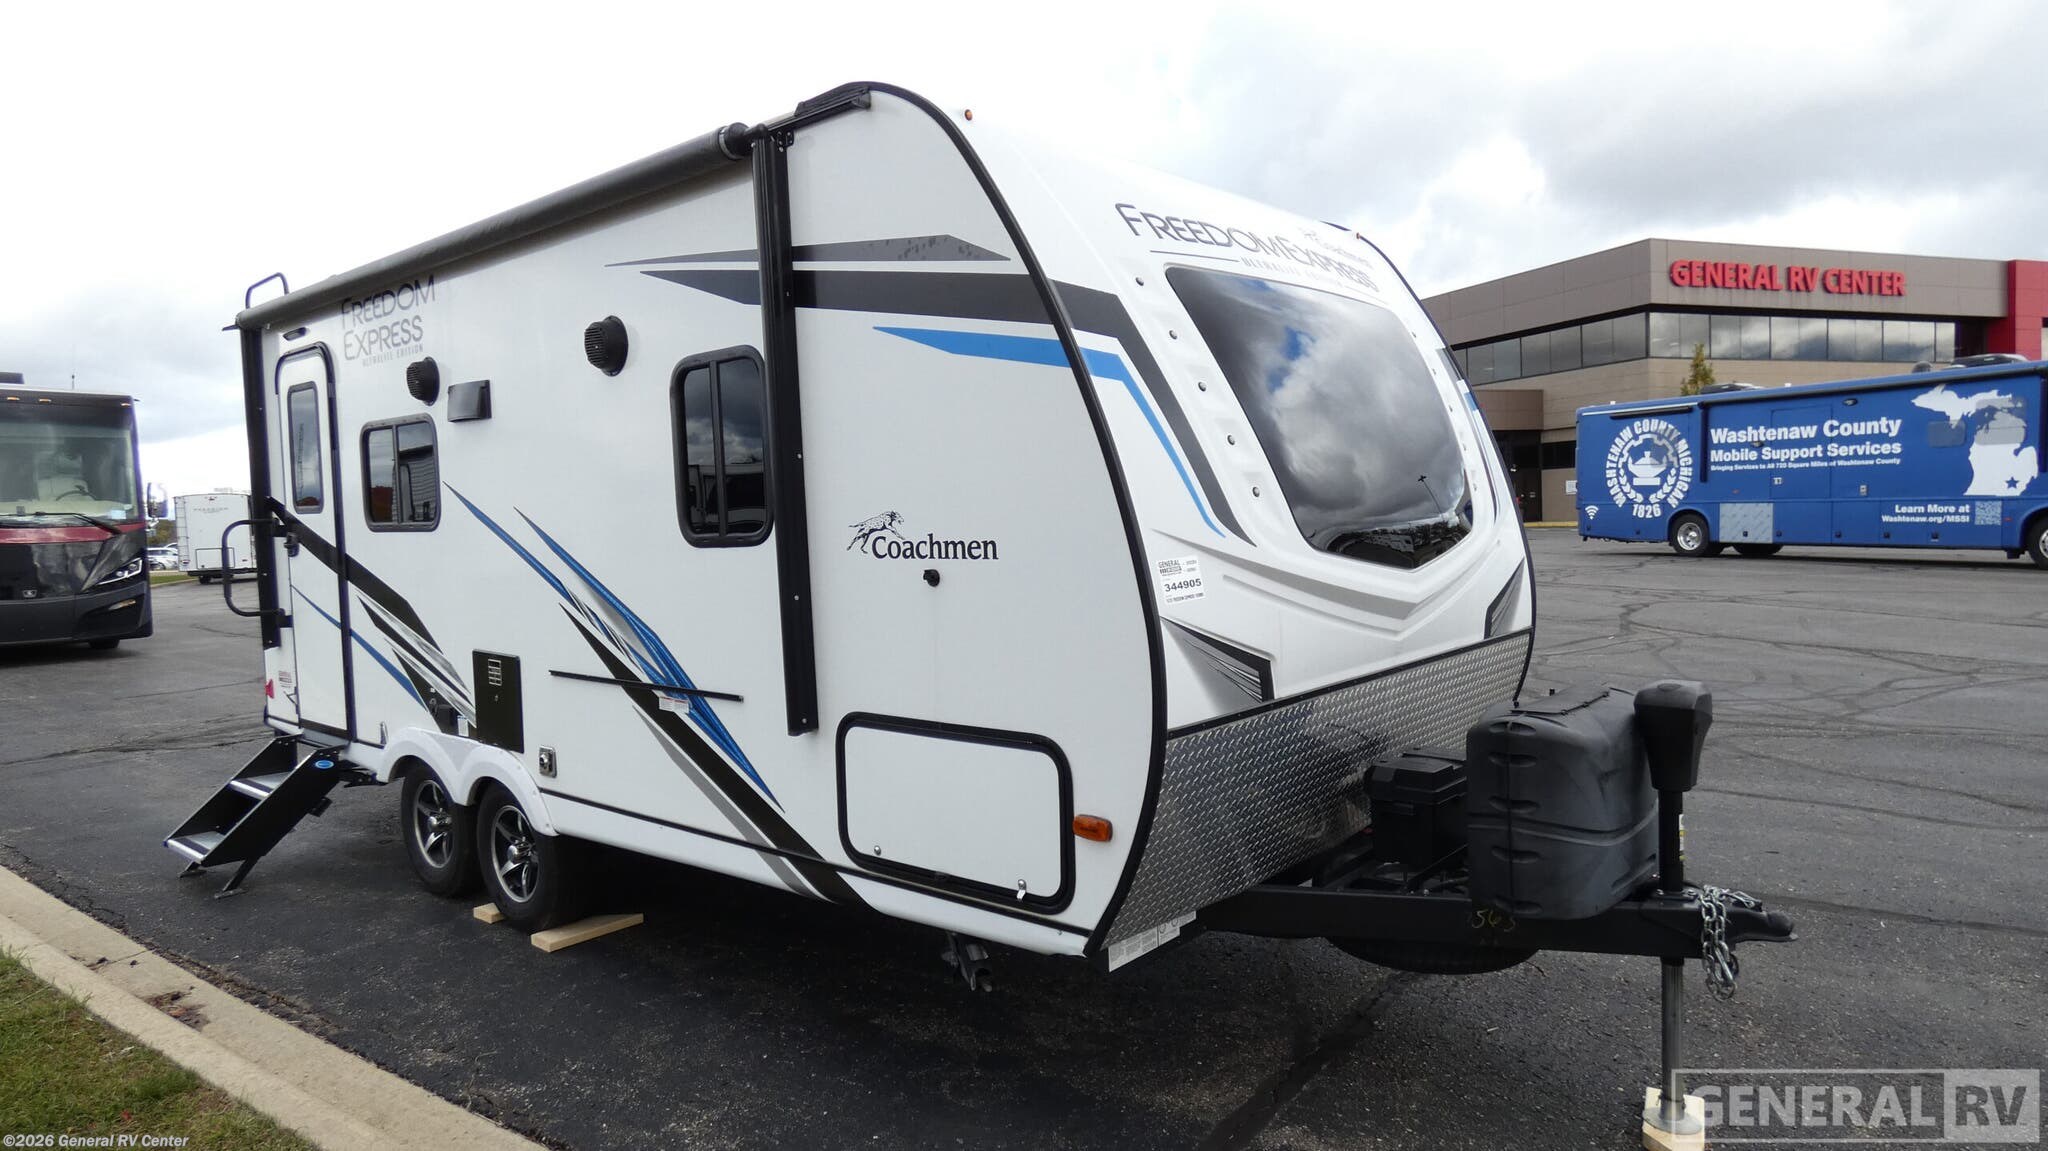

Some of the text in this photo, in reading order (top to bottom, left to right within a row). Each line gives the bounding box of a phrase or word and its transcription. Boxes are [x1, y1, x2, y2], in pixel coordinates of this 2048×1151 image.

[1670, 260, 1905, 296] GENERAL RV CENTER
[342, 274, 435, 330] FREEDOM
[344, 315, 423, 361] EXPRESS
[1711, 416, 1902, 444] Washtenaw County
[1606, 419, 1693, 508] WASHTENAW COUNTY MICHIGAN
[1711, 441, 1902, 462] Mobile Support Services
[1734, 463, 1758, 471] Services
[1876, 457, 1901, 465] County
[1632, 504, 1661, 519] 1826
[1895, 503, 1970, 513] Learn More at
[872, 533, 999, 560] Coachmen
[1164, 578, 1202, 592] 344905
